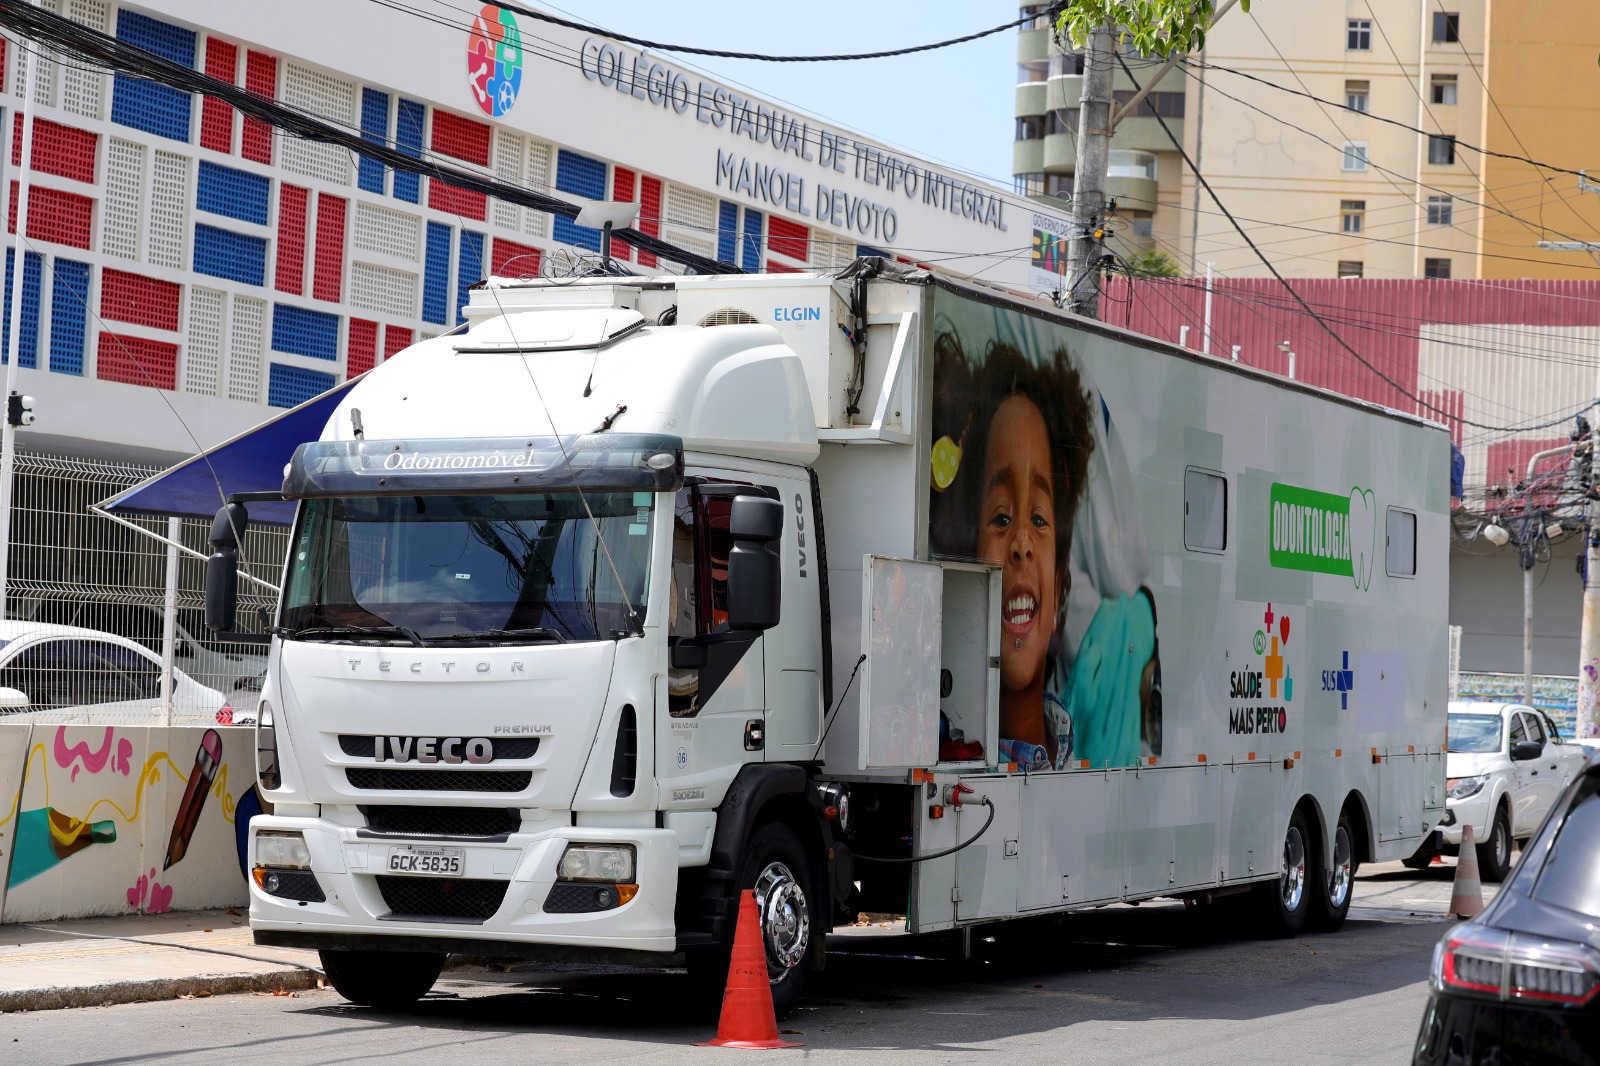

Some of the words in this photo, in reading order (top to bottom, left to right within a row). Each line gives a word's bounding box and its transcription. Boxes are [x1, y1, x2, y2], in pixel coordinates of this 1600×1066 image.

[581, 37, 690, 115] COLÉGIO
[696, 82, 813, 161] ESTADUAL
[819, 129, 848, 174] DE
[853, 140, 919, 199] TEMPO
[922, 169, 1008, 232] INTEGRAL
[716, 148, 811, 216] MANOEL
[816, 183, 898, 244] DEVOTO
[1033, 213, 1060, 234] GOVERNO
[774, 307, 820, 321] ELGIN
[384, 449, 535, 470] Odontomóvel
[795, 493, 807, 578] IVECO
[1273, 500, 1351, 561] ODONTOLOGIA
[348, 658, 525, 673] TECTOR
[1230, 664, 1262, 699] SAÚDE
[1321, 669, 1336, 691] SUS
[493, 724, 551, 734] PREMIUM
[1229, 706, 1254, 735] MAIS
[1256, 706, 1286, 734] PERTO
[374, 736, 494, 764] IVECO
